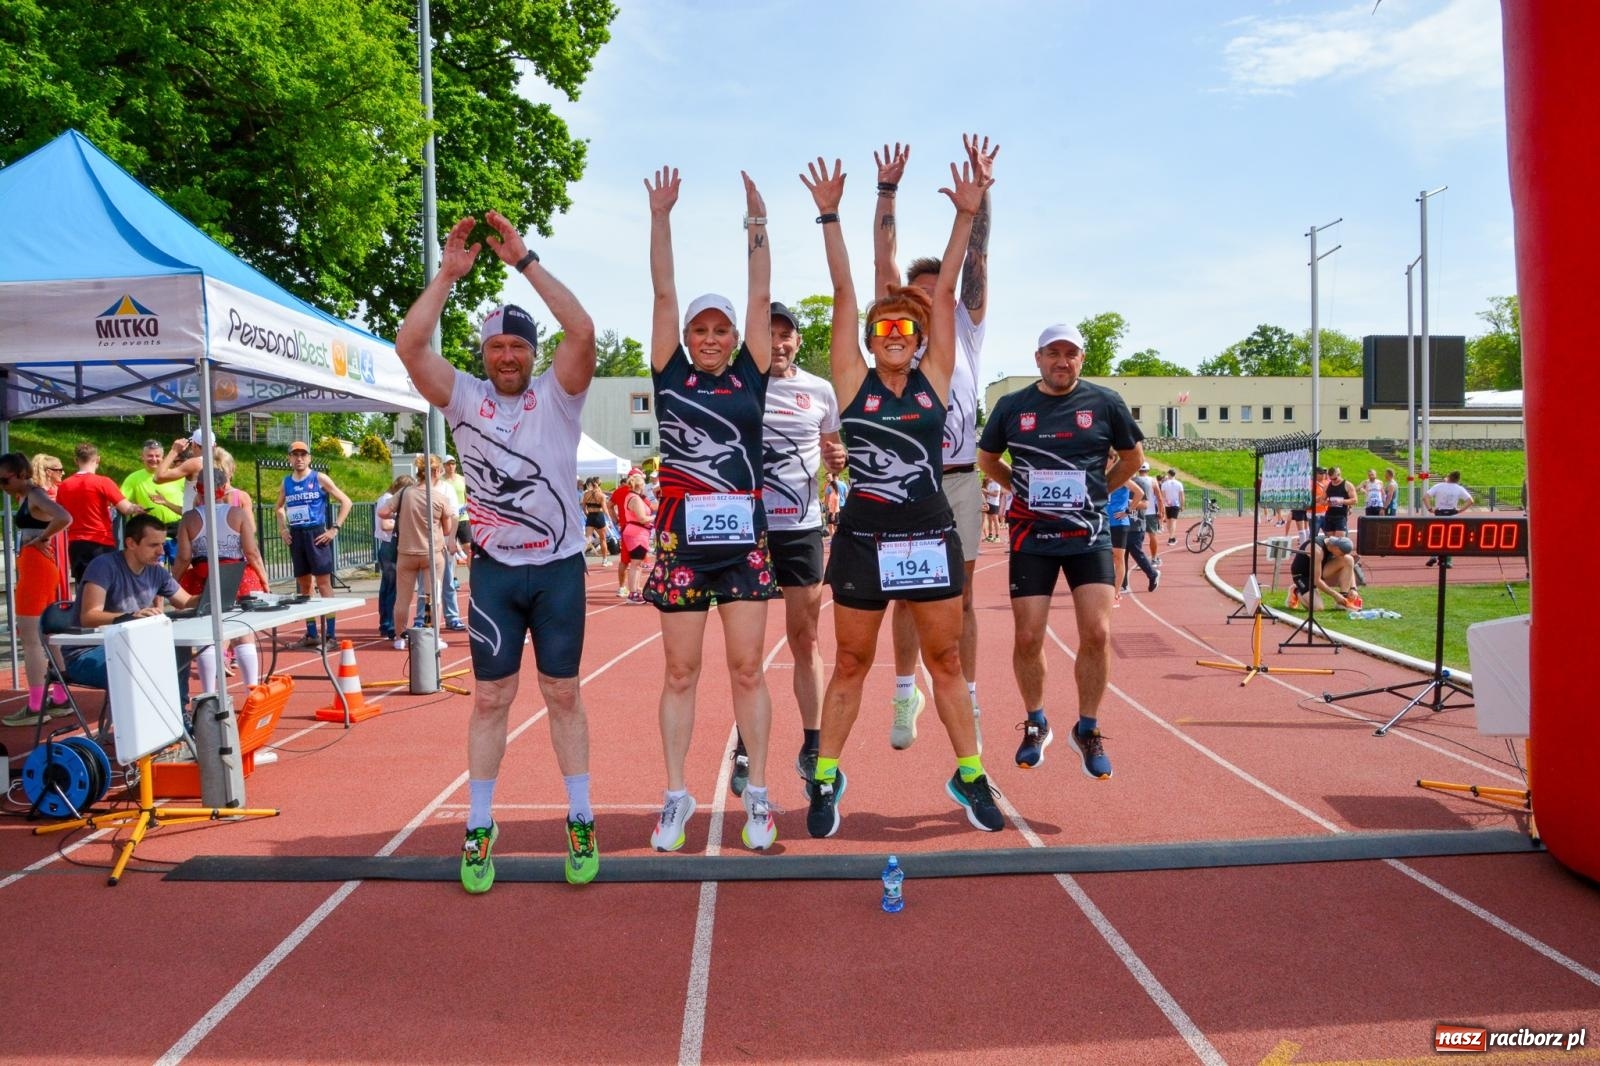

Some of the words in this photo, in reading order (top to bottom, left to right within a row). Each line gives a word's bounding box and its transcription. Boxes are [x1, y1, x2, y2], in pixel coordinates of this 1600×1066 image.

[95, 317, 159, 339] MITKO
[1042, 486, 1072, 499] 264
[703, 514, 738, 531] 256
[1395, 523, 1518, 549] 0:00:00
[896, 559, 930, 576] 194
